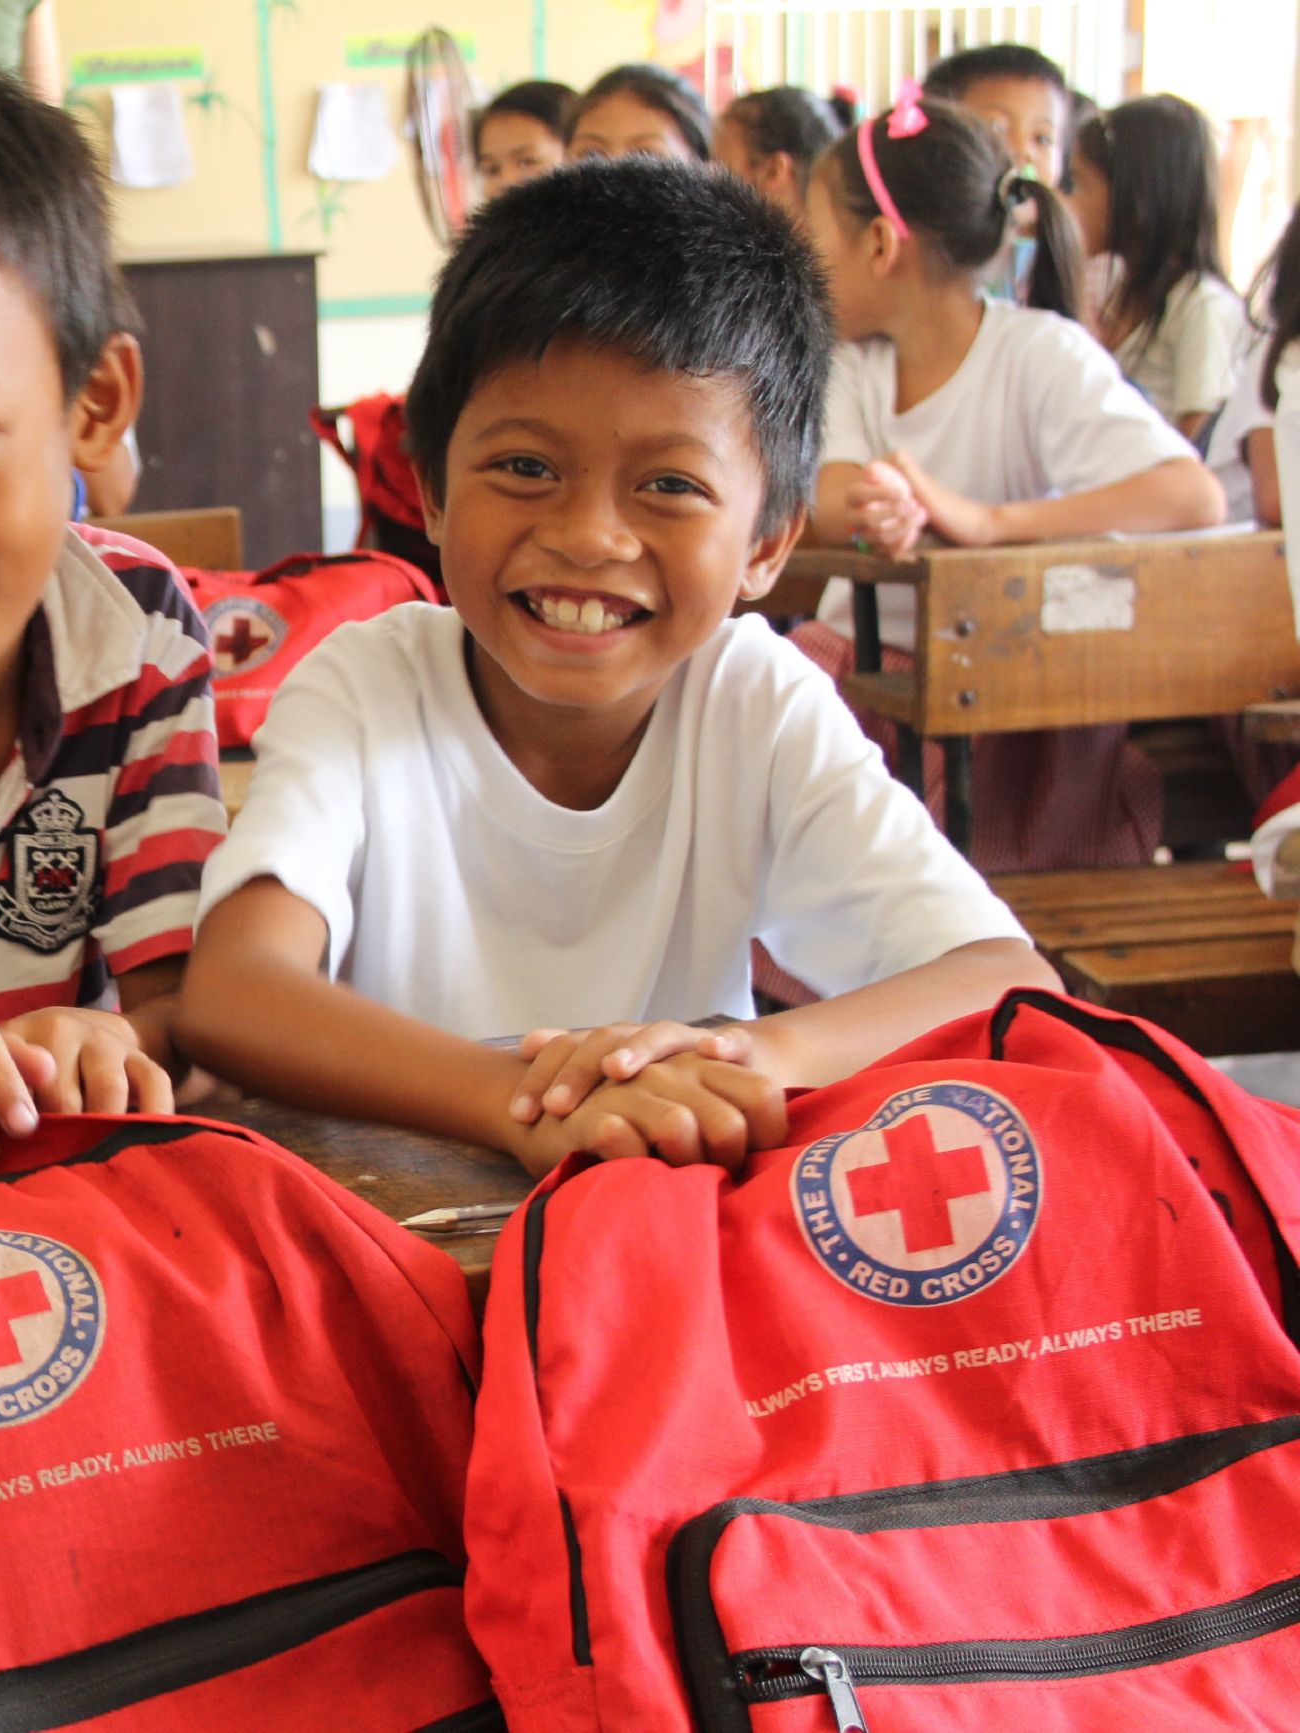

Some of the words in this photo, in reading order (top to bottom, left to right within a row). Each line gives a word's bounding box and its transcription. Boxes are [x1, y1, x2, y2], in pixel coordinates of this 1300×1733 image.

[803, 1188, 841, 1256] THE
[946, 1088, 1035, 1215] NATIONAL
[847, 1260, 911, 1299] RED
[920, 1234, 1017, 1300] CROSS
[824, 1360, 881, 1386] FIRST,
[879, 1353, 949, 1380] ALWAYS
[953, 1338, 1037, 1371] READY,
[1039, 1321, 1123, 1356] ALWAYS
[1125, 1308, 1203, 1337] THERE
[36, 1451, 120, 1489] READY,
[122, 1436, 202, 1469] ALWAYS
[205, 1420, 280, 1451] THERE
